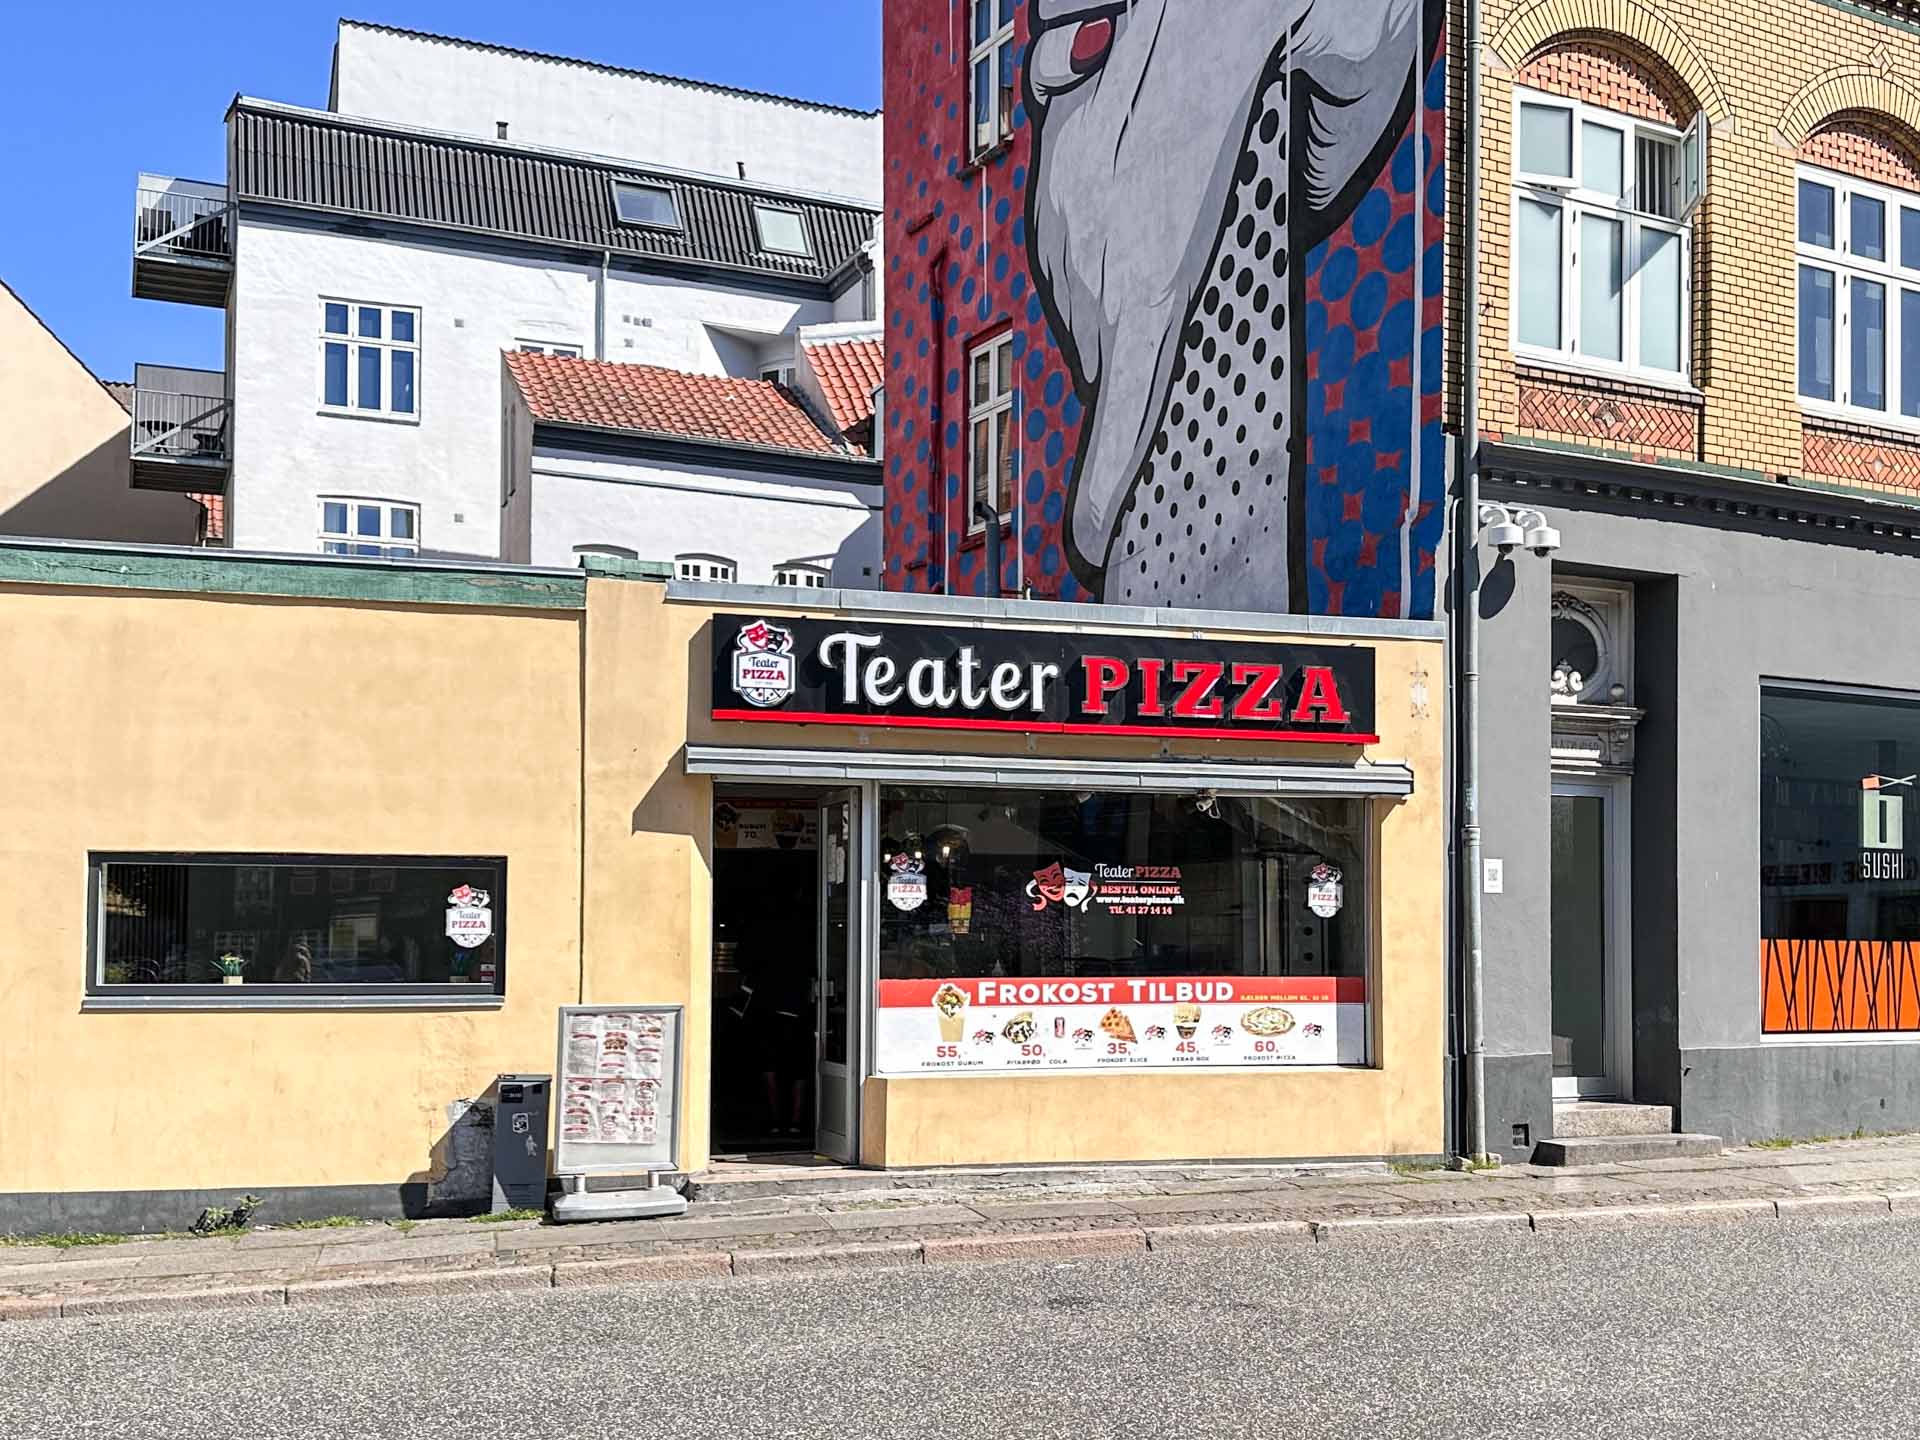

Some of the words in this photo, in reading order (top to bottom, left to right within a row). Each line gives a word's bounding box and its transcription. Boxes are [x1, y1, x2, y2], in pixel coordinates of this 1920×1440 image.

[749, 657, 779, 668] Teater
[742, 669, 785, 681] PIZZA
[819, 632, 1059, 710] Teater
[1081, 655, 1350, 724] PIZZA
[1095, 863, 1134, 878] Teater
[1135, 866, 1181, 878] PIZZA
[1862, 851, 1904, 880] SUSHI
[1100, 885, 1138, 894] BESTIL
[1140, 885, 1180, 895] ONLINE
[1138, 905, 1149, 914] 27
[451, 921, 486, 929] PIZZA
[978, 981, 1115, 1004] FROKOST
[1127, 979, 1235, 1002] TILBUD
